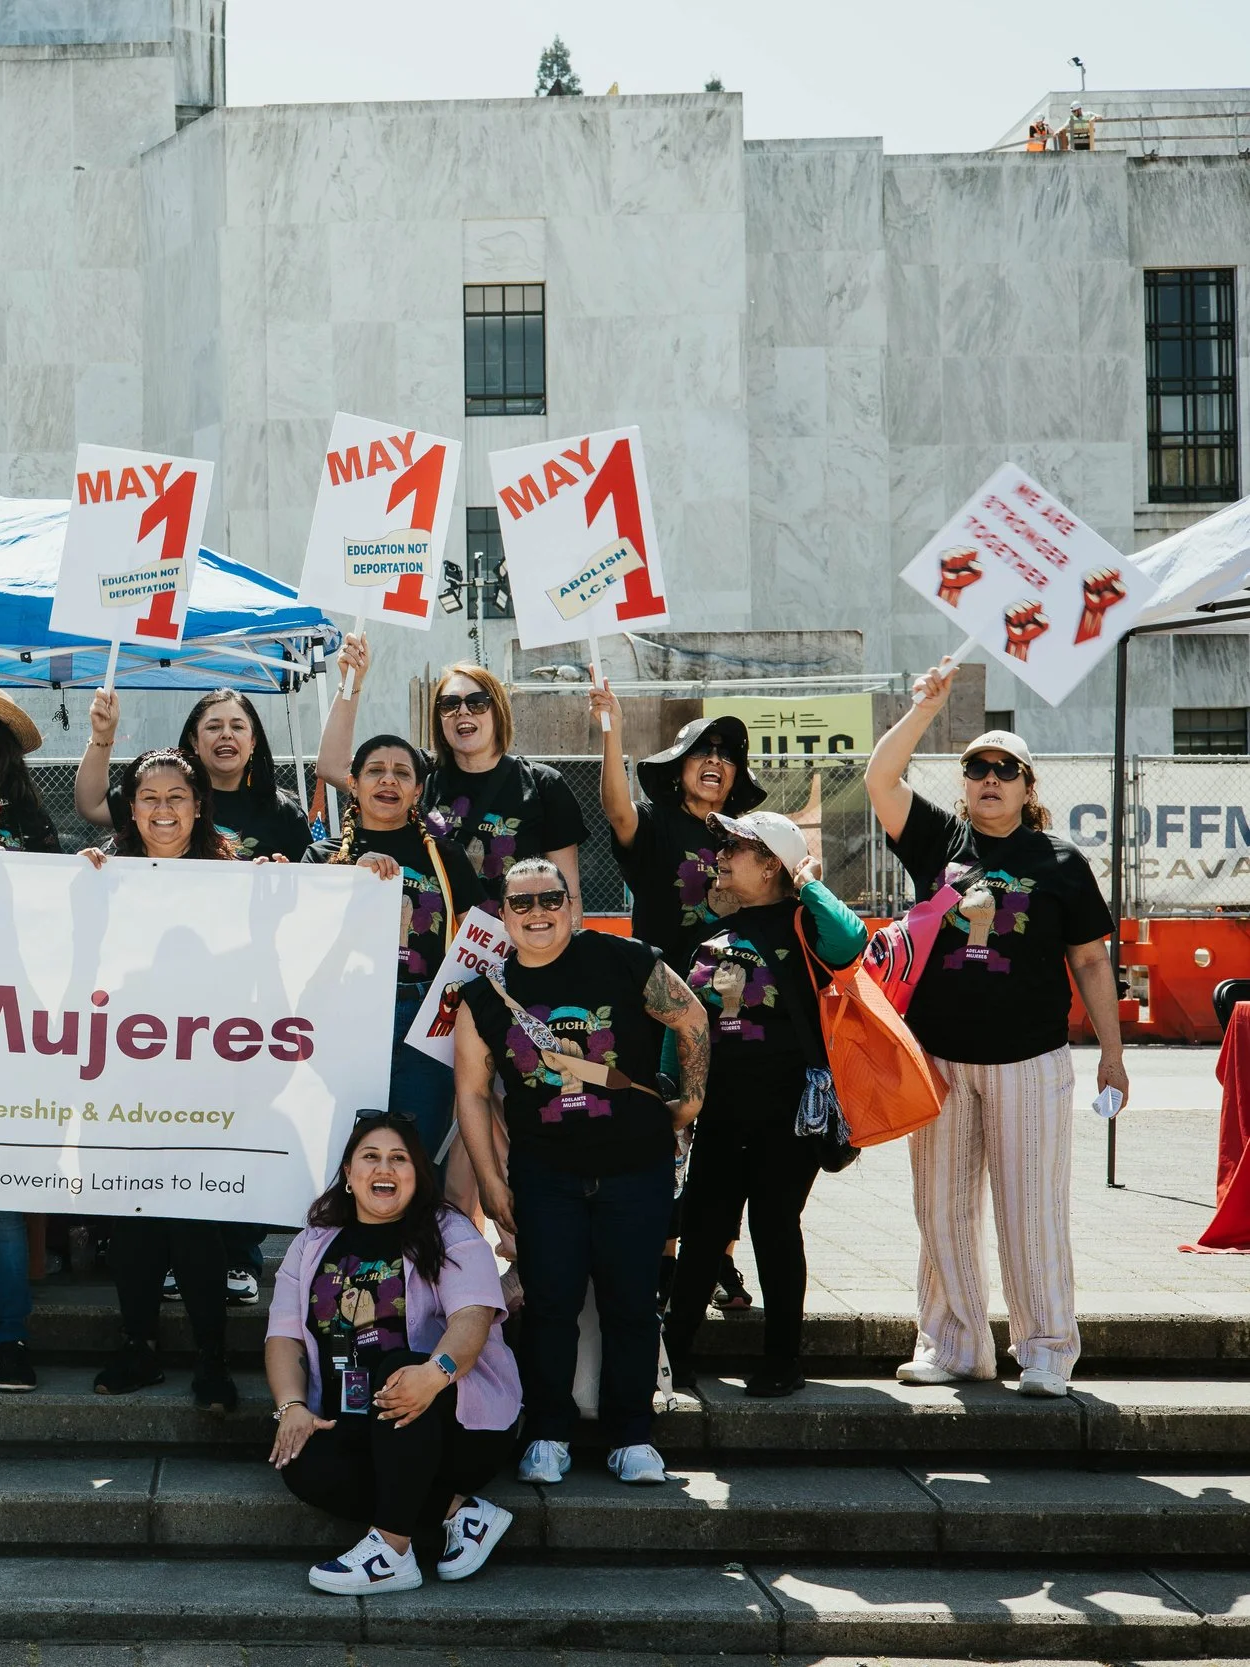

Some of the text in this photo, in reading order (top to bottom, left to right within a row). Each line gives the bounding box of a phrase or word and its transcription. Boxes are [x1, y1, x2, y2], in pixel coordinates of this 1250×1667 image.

[327, 431, 446, 618] MAY 1
[499, 437, 666, 621] MAY 1
[77, 462, 197, 640] MAY 1
[347, 543, 428, 556] EDUCATION NOT
[102, 567, 180, 587] EDUCATION NOT
[353, 562, 423, 574] DEPORTATION
[559, 548, 628, 598] ABOLISH
[109, 581, 176, 599] DEPORTATION
[466, 924, 493, 949] WE
[456, 946, 494, 975] TOG
[561, 1095, 587, 1103] ADELANTE
[563, 1101, 586, 1109] MUJERES
[82, 1102, 100, 1121] &
[107, 1102, 236, 1130] Advocacy
[92, 1173, 164, 1191] Latinas
[171, 1173, 192, 1191] to
[200, 1171, 245, 1194] lead
[356, 1330, 379, 1340] ADELANTE
[357, 1336, 379, 1345] MUJERES
